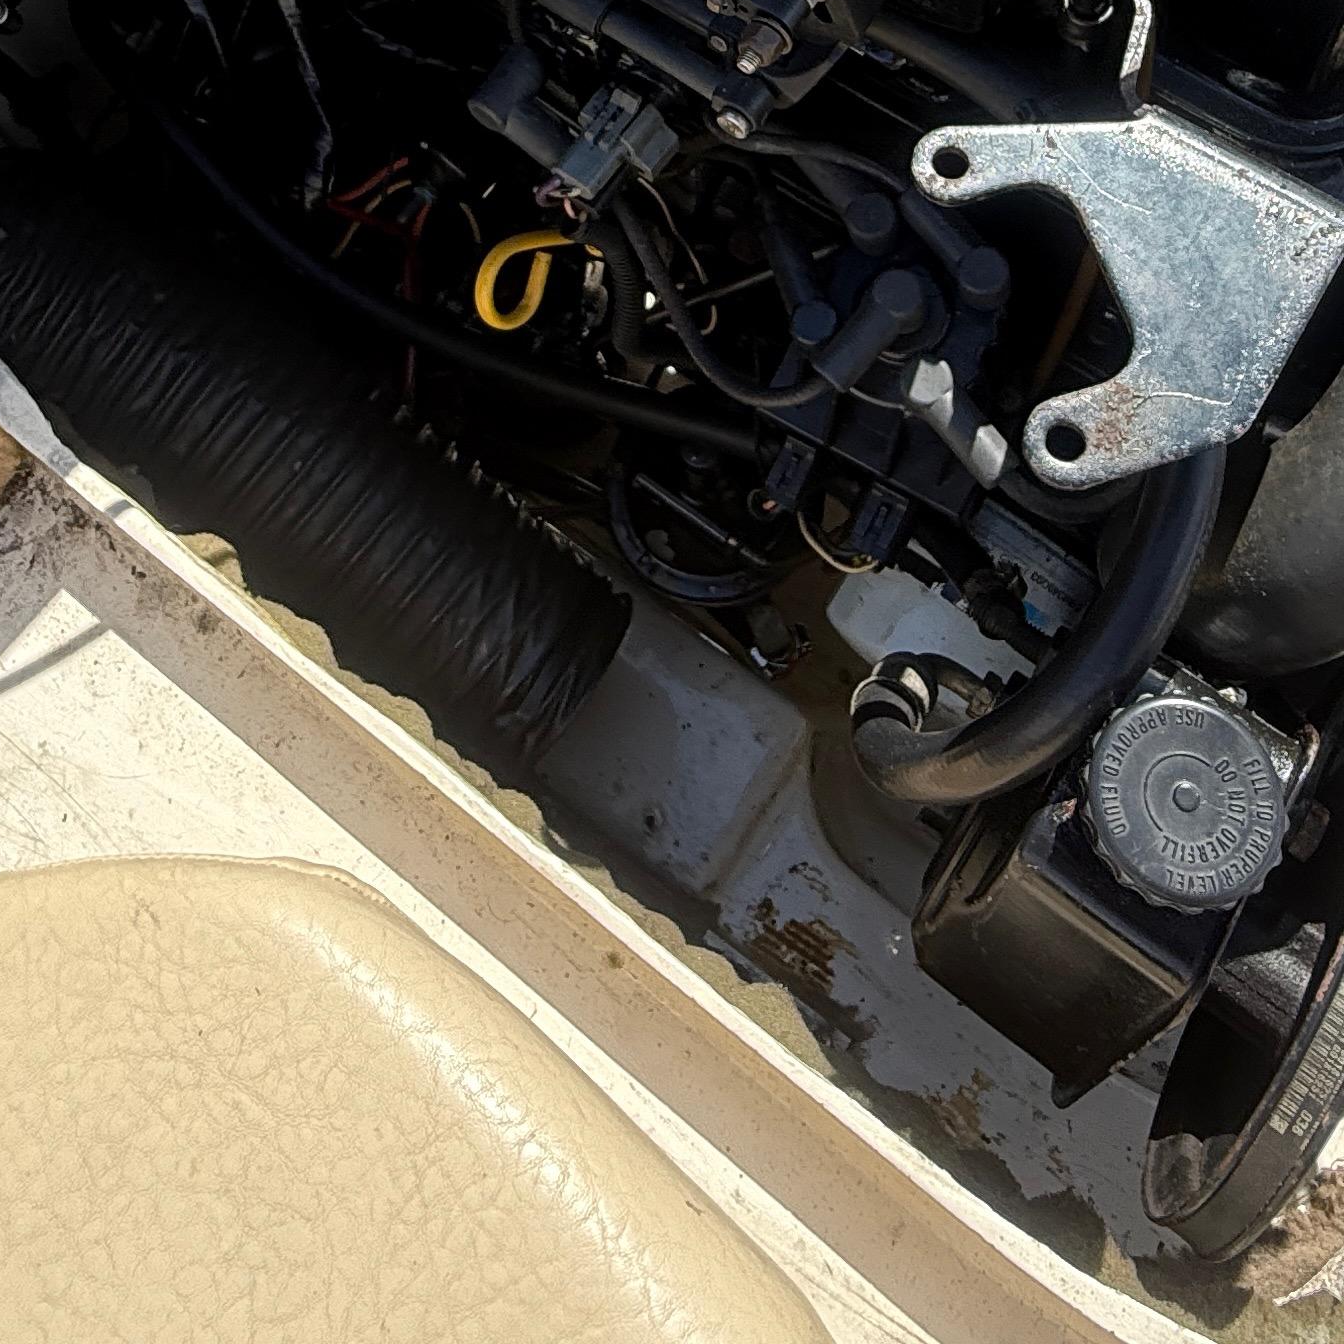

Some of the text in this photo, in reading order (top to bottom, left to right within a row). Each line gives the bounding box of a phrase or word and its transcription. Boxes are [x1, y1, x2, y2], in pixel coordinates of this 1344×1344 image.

[1101, 708, 1205, 836] USE APPROVED FLUID
[1160, 758, 1247, 865] DO NOT OVERFILL
[1165, 758, 1275, 893] FILL TO PROPER LEVEL
